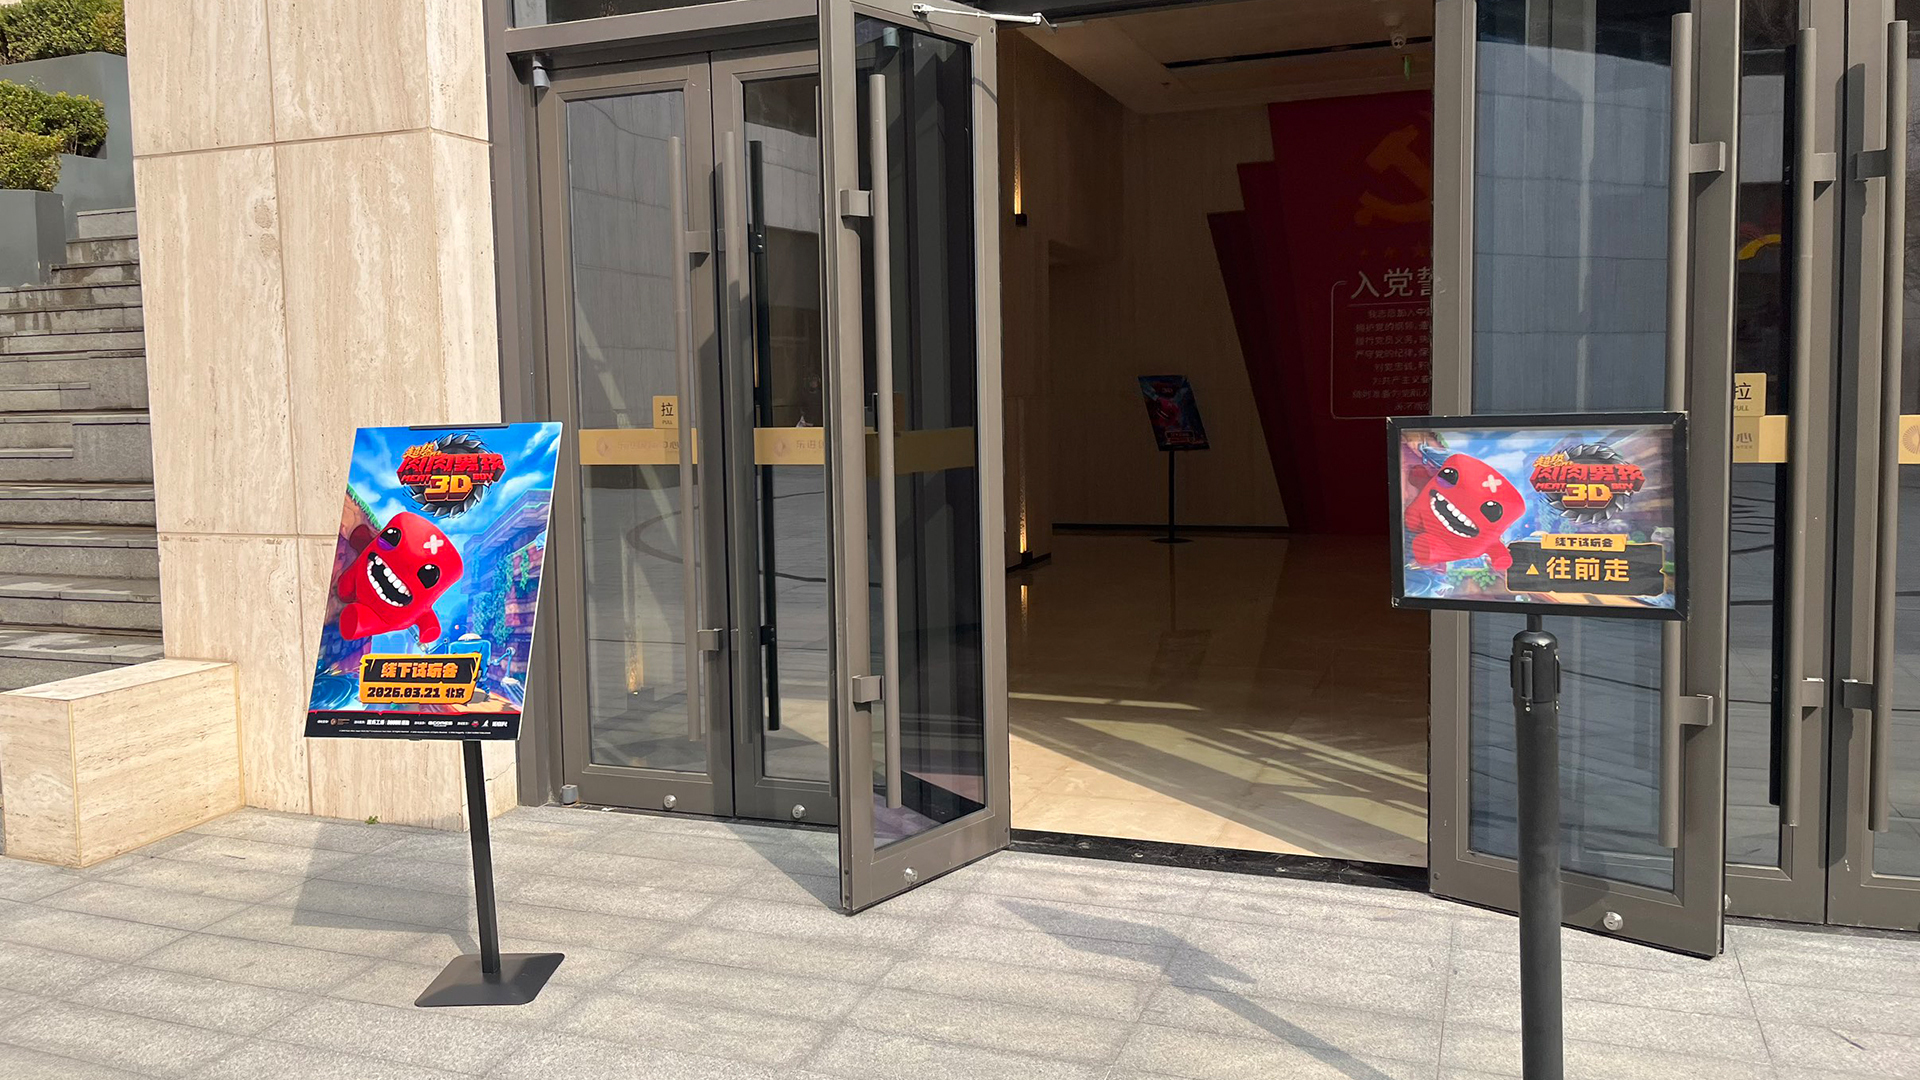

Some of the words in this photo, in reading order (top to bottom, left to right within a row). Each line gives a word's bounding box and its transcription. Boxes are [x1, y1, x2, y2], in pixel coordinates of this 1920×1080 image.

[661, 402, 674, 416] 拉
[398, 454, 505, 472] 肉肉男孩
[1533, 453, 1566, 467] 超级
[1531, 464, 1645, 481] 肉肉男孩
[424, 475, 473, 499] 3D
[1562, 484, 1613, 506] 3D
[1554, 537, 1613, 547] 线下试玩会
[1546, 556, 1630, 582] 往前走
[381, 662, 458, 678] 线下试玩会
[367, 687, 440, 698] 2026.03.21
[445, 687, 466, 698] 北京
